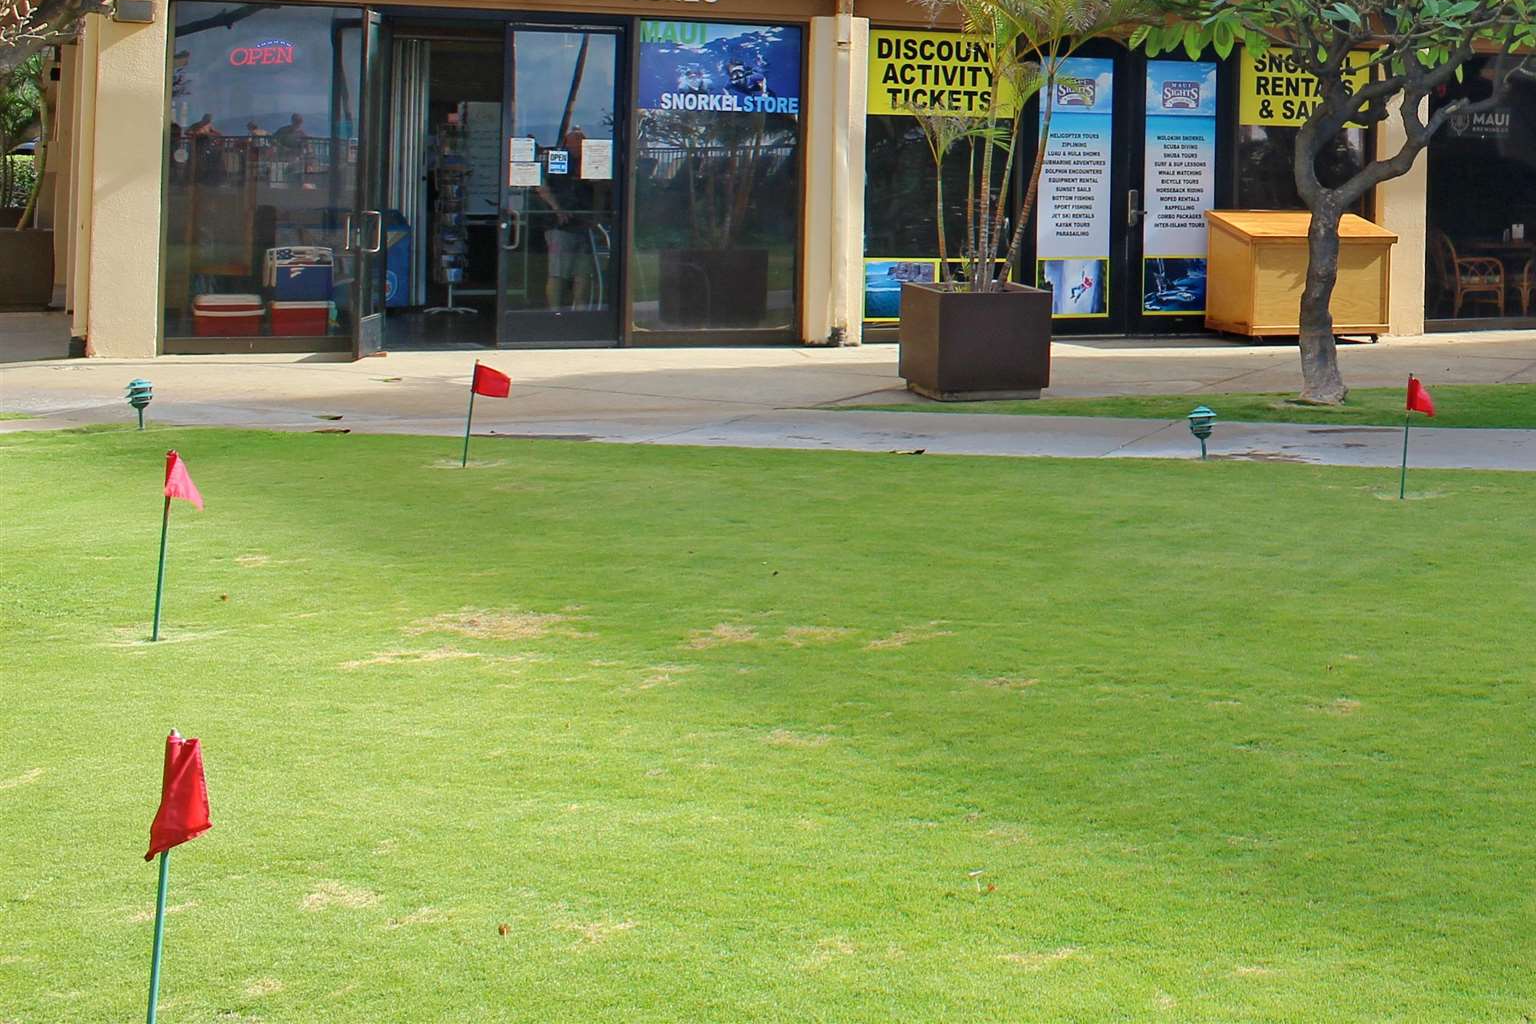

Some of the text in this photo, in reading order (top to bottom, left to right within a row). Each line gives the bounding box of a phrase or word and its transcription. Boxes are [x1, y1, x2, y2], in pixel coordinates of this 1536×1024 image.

[640, 21, 707, 45] MAUI
[229, 47, 295, 66] OPEN
[877, 38, 995, 63] DISCOUN
[882, 63, 995, 88] ACTIVITY
[886, 87, 992, 112] TICKETS
[1163, 87, 1199, 100] SIGHTS
[1258, 99, 1274, 119] &
[1472, 112, 1510, 127] MAUI
